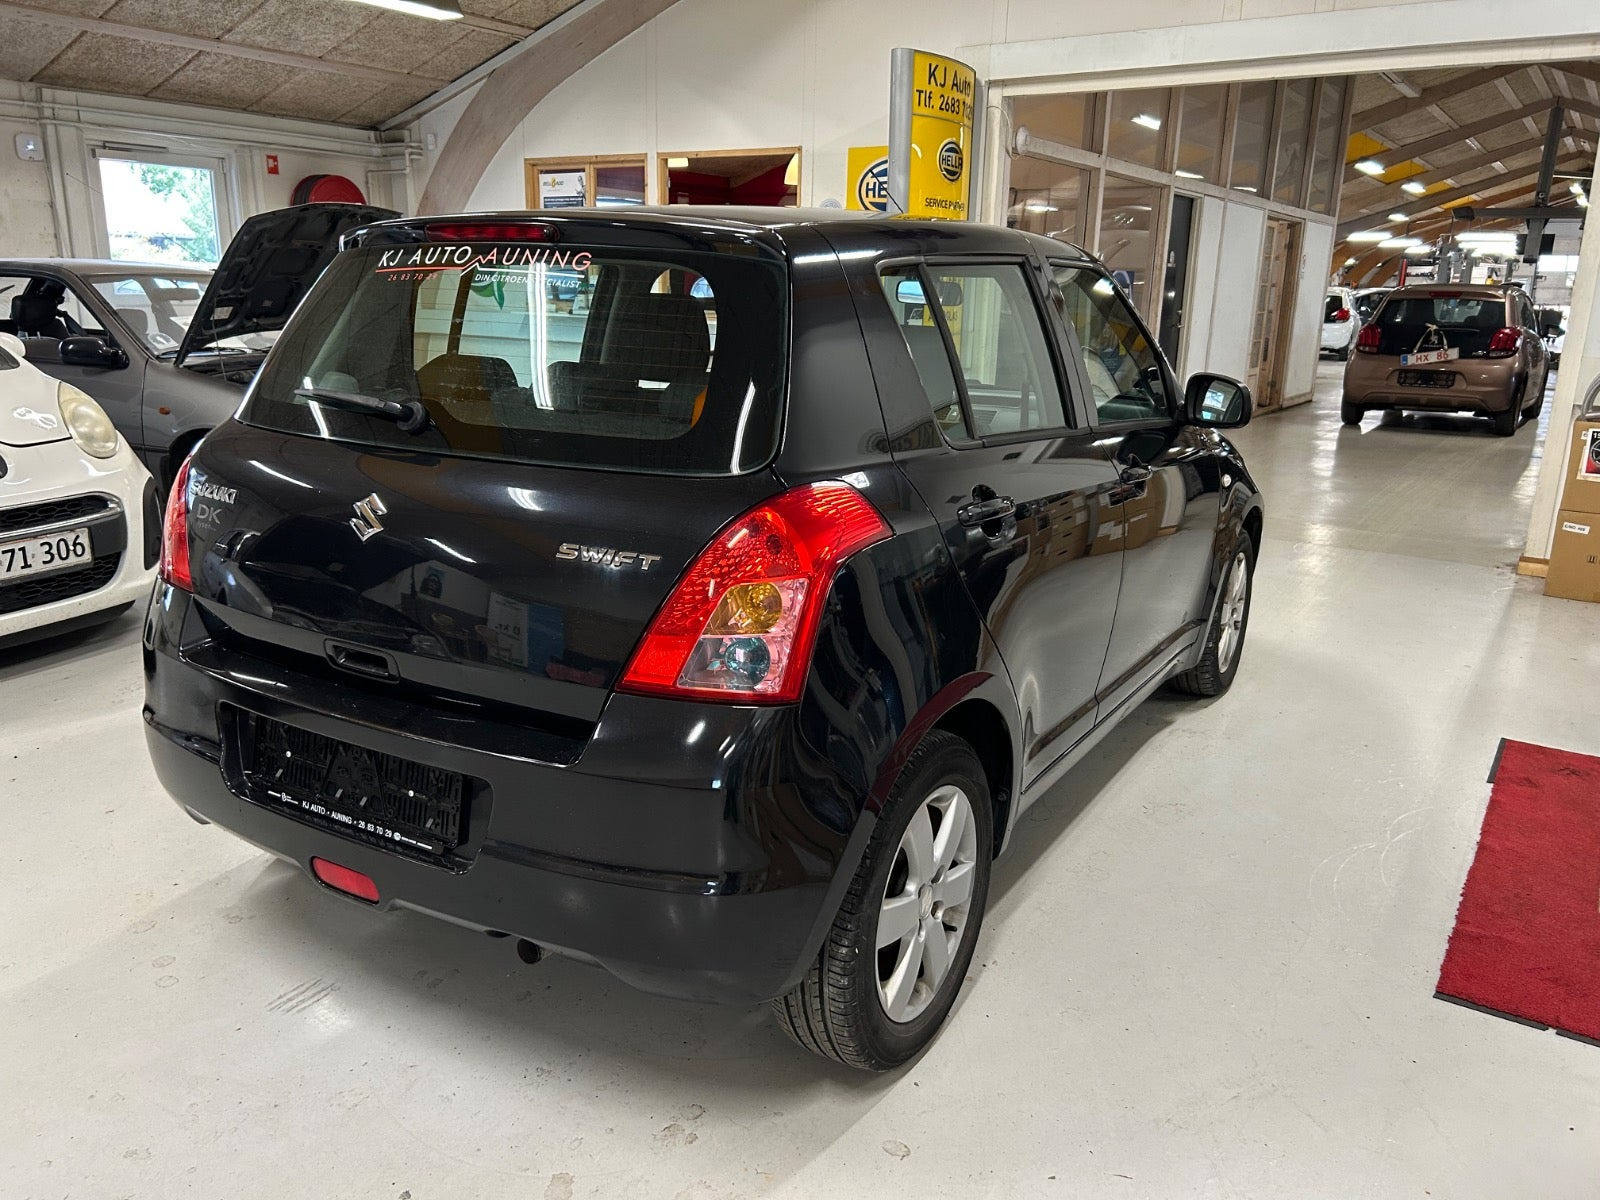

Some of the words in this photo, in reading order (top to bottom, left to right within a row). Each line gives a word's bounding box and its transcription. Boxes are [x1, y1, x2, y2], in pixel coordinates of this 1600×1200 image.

[928, 63, 948, 88] KJ
[951, 70, 972, 98] Auto
[915, 89, 935, 109] Tlf.
[938, 94, 961, 116] 2683
[924, 197, 948, 209] SERVICE
[378, 249, 403, 268] KJ
[408, 245, 473, 265] AUTO
[483, 247, 593, 271] AUNING
[387, 273, 398, 282] 26
[400, 273, 411, 281] 83
[413, 272, 424, 281] 70
[475, 273, 490, 282] DIN
[530, 276, 582, 289] CIALIST
[1415, 354, 1430, 363] HX
[1436, 351, 1449, 361] 86
[191, 481, 238, 505] SUZUKI
[196, 503, 223, 525] DK
[1, 546, 33, 573] 71
[39, 534, 86, 565] 306
[555, 542, 662, 571] SWIFT
[302, 800, 310, 809] KJ
[310, 803, 326, 815] AUTO
[331, 810, 353, 825] AUNING
[358, 820, 366, 829] 26
[367, 823, 375, 832] 83
[376, 826, 384, 835] 70
[384, 829, 392, 838] 29
